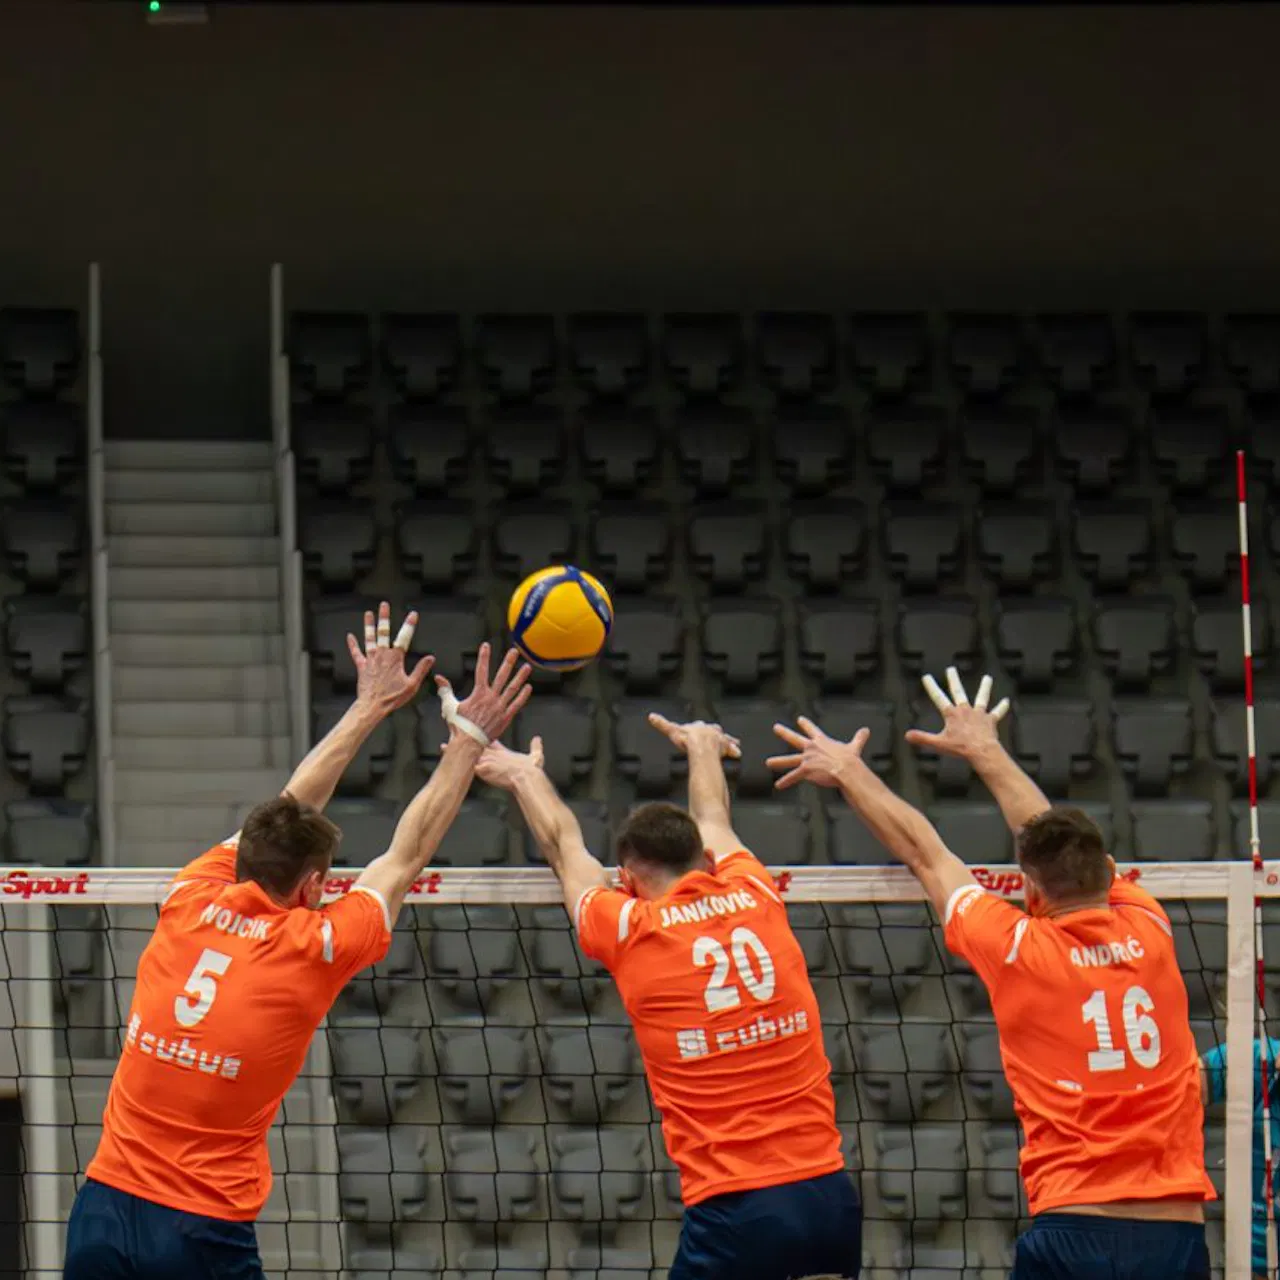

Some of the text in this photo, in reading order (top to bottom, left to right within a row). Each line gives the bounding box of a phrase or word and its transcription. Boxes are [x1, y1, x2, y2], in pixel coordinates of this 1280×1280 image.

[659, 888, 758, 928] JANKOVIĆ
[174, 948, 232, 1027] 5
[692, 926, 776, 1013] 20
[140, 1033, 242, 1080] cubus
[716, 1010, 809, 1052] cubus
[1081, 985, 1162, 1072] 16
